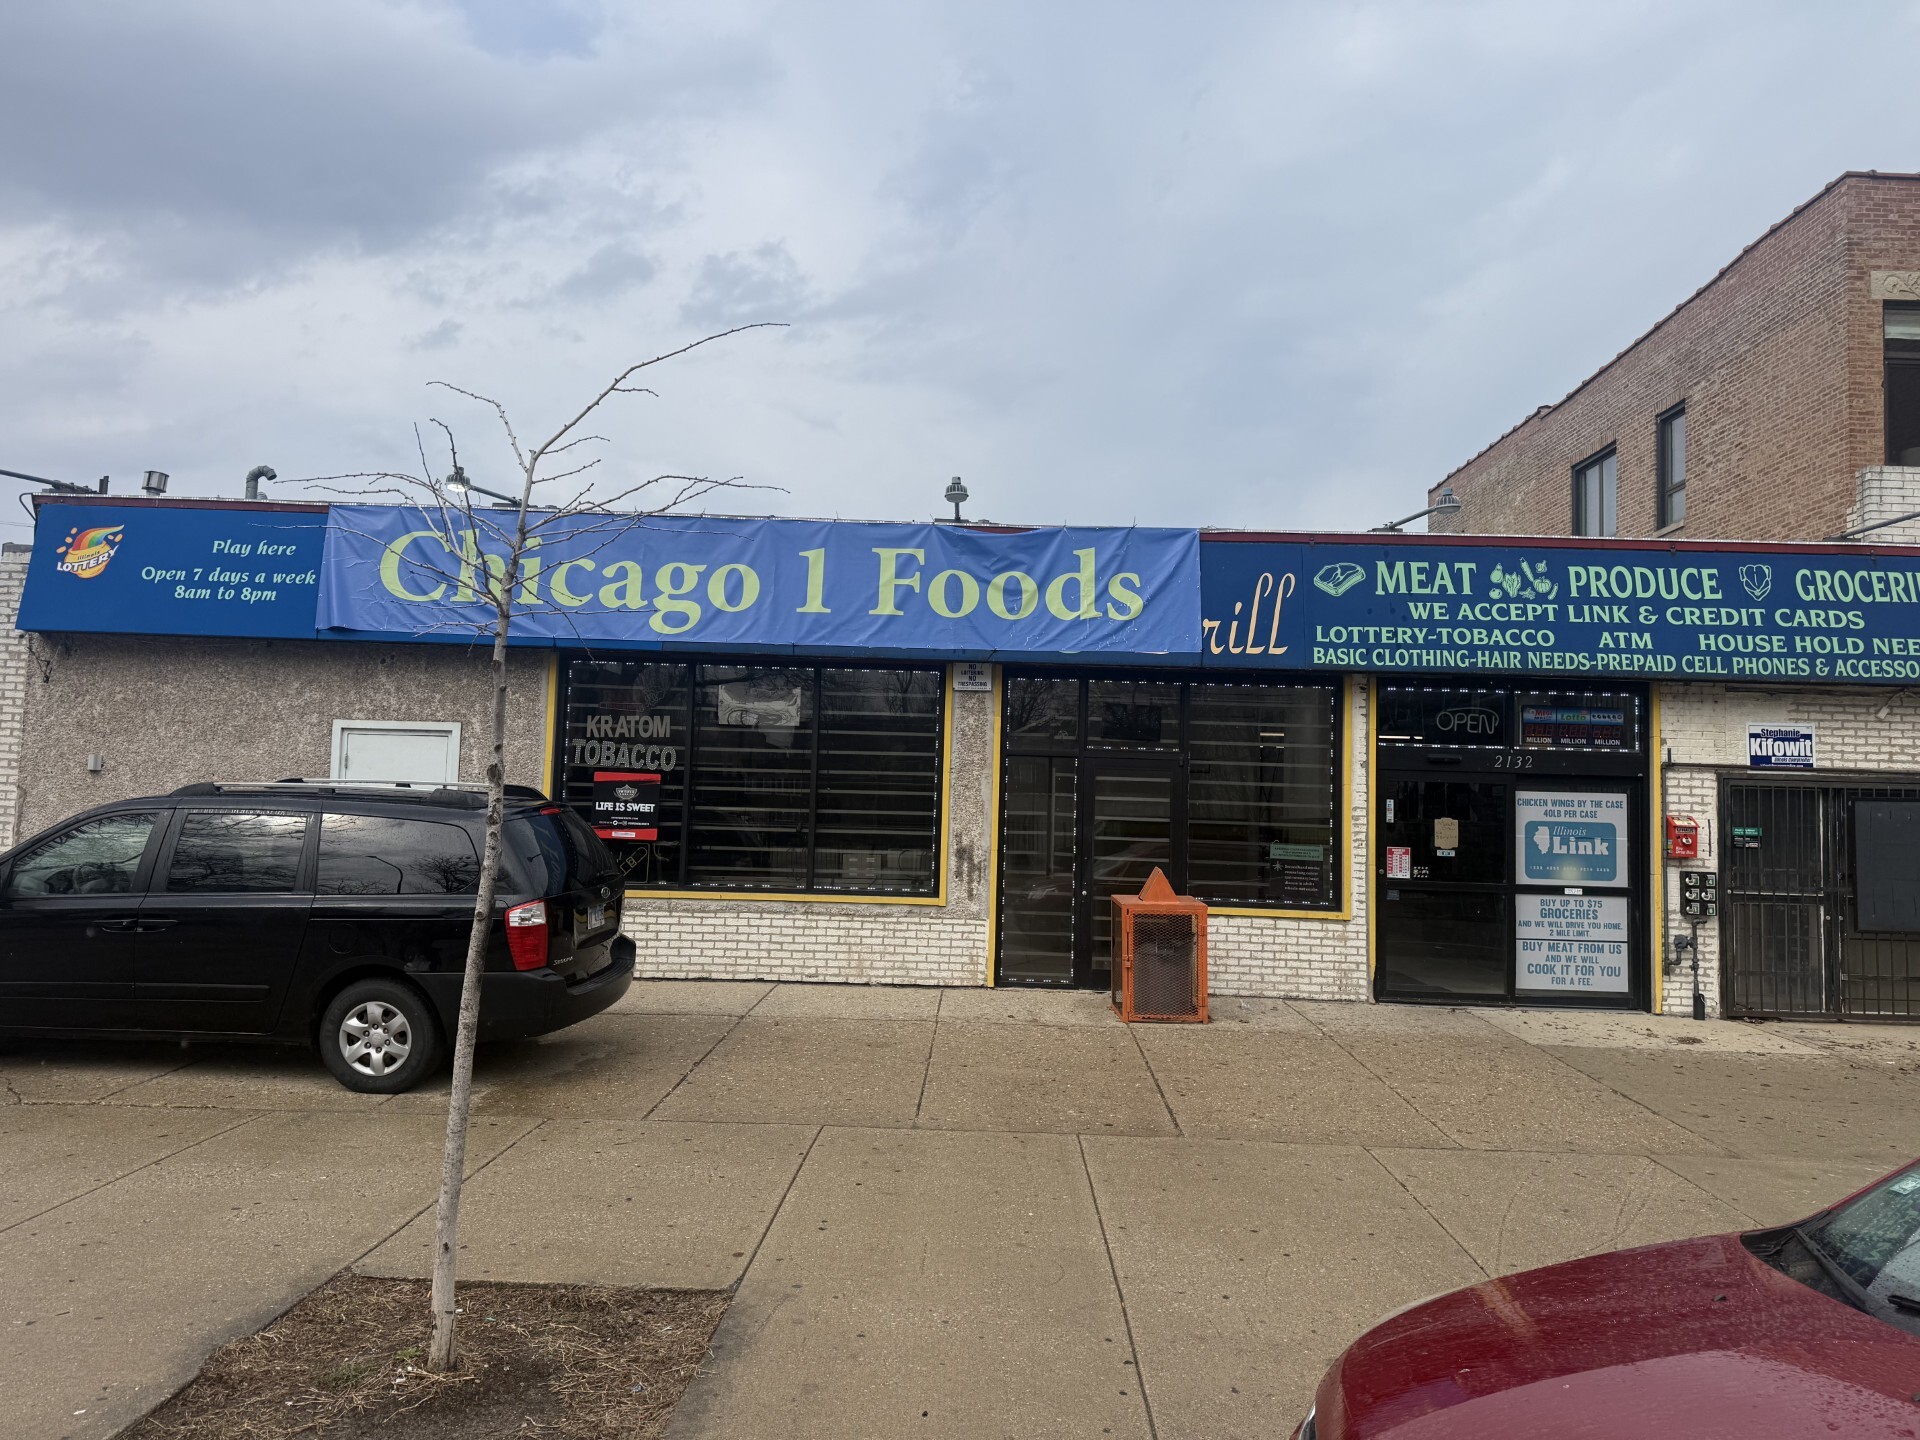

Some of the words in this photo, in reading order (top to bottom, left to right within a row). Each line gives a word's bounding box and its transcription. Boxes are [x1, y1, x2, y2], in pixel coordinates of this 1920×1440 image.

[211, 540, 252, 557] Play
[256, 540, 297, 556] here
[56, 544, 120, 572] LOTTERY
[141, 566, 186, 584] Open
[193, 568, 203, 582] 7
[208, 567, 250, 585] days
[254, 571, 266, 584] a
[272, 569, 316, 585] week
[379, 528, 761, 634] Chicago
[796, 547, 832, 614] 1
[868, 547, 1145, 621] Foods
[1375, 560, 1478, 595] MEAT
[1567, 565, 1722, 600] PRODUCE
[174, 584, 211, 600] 8am
[217, 587, 235, 600] to
[240, 587, 278, 604] 8pm
[1408, 602, 1450, 620] WE
[1457, 603, 1559, 622] ACCEPT
[1567, 604, 1631, 624] LINK
[1638, 606, 1659, 625] &
[1666, 607, 1766, 627] CREDIT
[1774, 608, 1865, 630] CARDS
[1315, 625, 1555, 647] LOTTERY-TOBACCO
[1598, 631, 1654, 649] ATM
[1698, 633, 1787, 653] HOUSE
[1794, 636, 1864, 654] HOLD
[1313, 647, 1368, 666] BASIC
[1372, 649, 1522, 670] CLOTHING-HAIR
[1527, 652, 1677, 673] NEEDS-PREPAID
[1682, 655, 1728, 674] CELL
[1733, 657, 1810, 676] PHONES
[1815, 658, 1830, 677] &
[1834, 659, 1920, 678] ACCESSO
[1436, 710, 1496, 735] OPEN
[1560, 713, 1587, 721] Lotto
[586, 715, 671, 738] KRATOM
[1760, 728, 1801, 738] Stephanie
[1526, 736, 1553, 744] MILLION
[1750, 738, 1813, 756] Kifowit
[572, 738, 677, 772] TOBACCO
[1494, 755, 1533, 769] 2132
[595, 801, 614, 812] LIFE
[615, 802, 626, 812] IS
[626, 803, 656, 813] SWEET
[1517, 798, 1548, 807] CHICKEN
[1550, 799, 1575, 808] WINGS
[1577, 799, 1587, 808] BY
[1590, 800, 1603, 808] THE
[1605, 800, 1624, 809] CASE
[1543, 809, 1562, 818] 40LB
[1564, 810, 1577, 818] PER
[1579, 810, 1598, 819] CASE
[1553, 826, 1587, 836] Illinois
[1552, 836, 1609, 856] Link
[1540, 899, 1557, 907] BUY
[1560, 899, 1570, 907] UP
[1573, 899, 1584, 908] TO
[1587, 899, 1603, 909] $75
[1540, 908, 1599, 920] GROCERIES
[1556, 929, 1571, 937] MILE
[1565, 921, 1585, 929] DRIVE
[1522, 941, 1543, 951] BUY
[1548, 942, 1574, 953] MEAT
[1578, 943, 1605, 954] FROM
[1609, 944, 1622, 955] US
[1545, 955, 1561, 963] AND
[1565, 955, 1577, 963] WE
[1580, 956, 1599, 964] WILL
[1527, 963, 1556, 975] COOK
[1561, 964, 1571, 975] IT
[1575, 965, 1595, 976] FOR
[1599, 966, 1621, 977] YOU
[1552, 977, 1566, 985] FOR
[1569, 977, 1575, 985] A
[1578, 977, 1593, 986] FEE.
